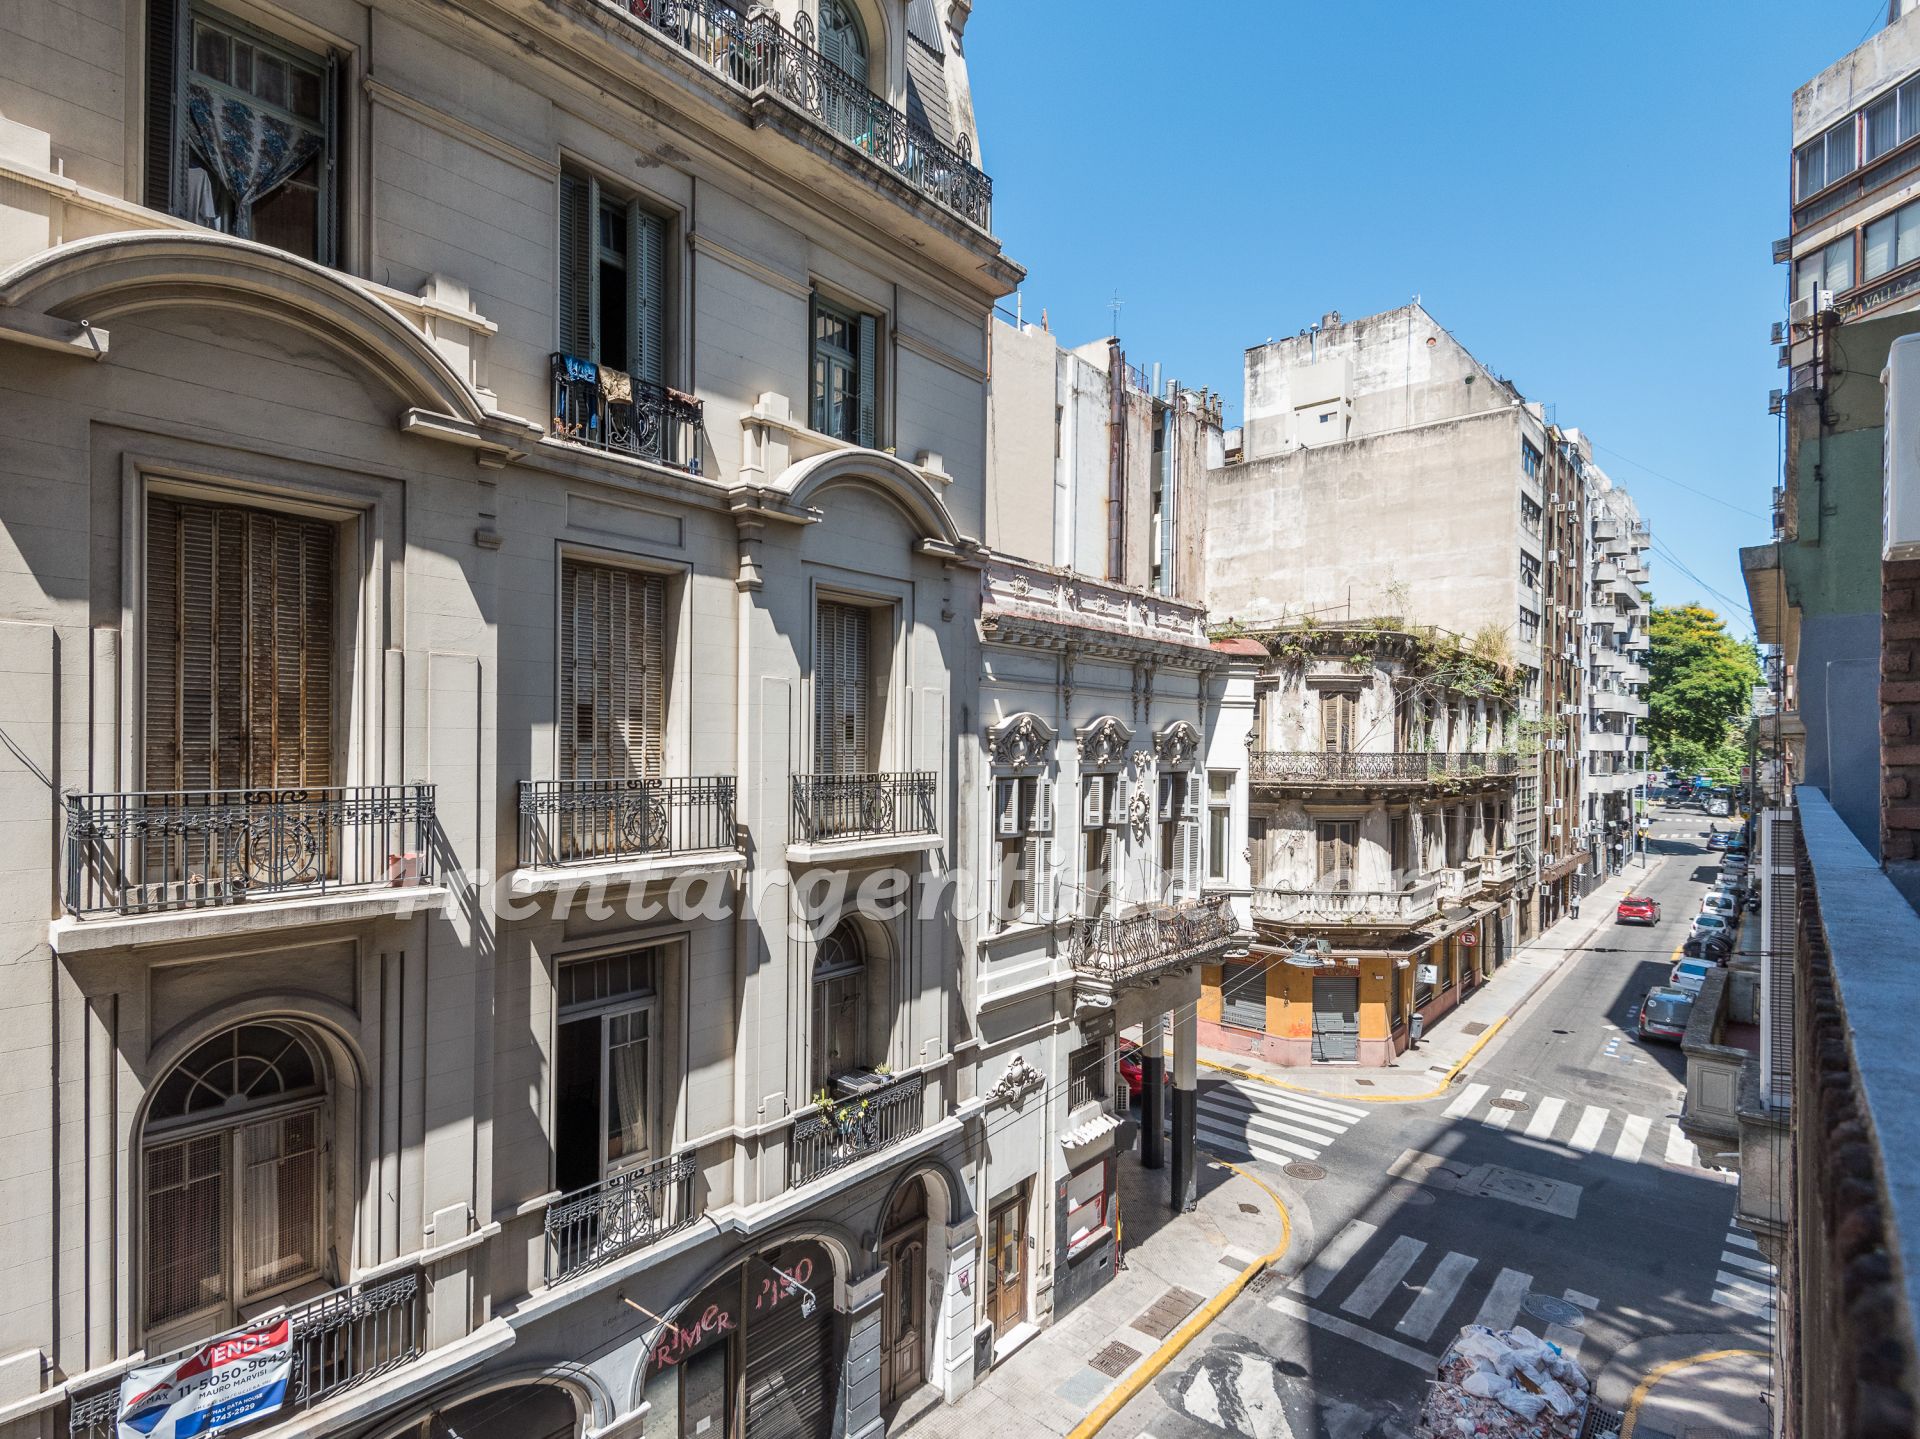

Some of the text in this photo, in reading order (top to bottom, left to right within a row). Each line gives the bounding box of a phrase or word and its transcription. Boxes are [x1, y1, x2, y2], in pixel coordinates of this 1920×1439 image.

[198, 1333, 271, 1367] VENDE
[177, 1350, 288, 1398] 11-5050-9642
[199, 1382, 231, 1399] MAURO
[233, 1368, 268, 1387] MARVISI
[226, 1400, 243, 1411] DATA
